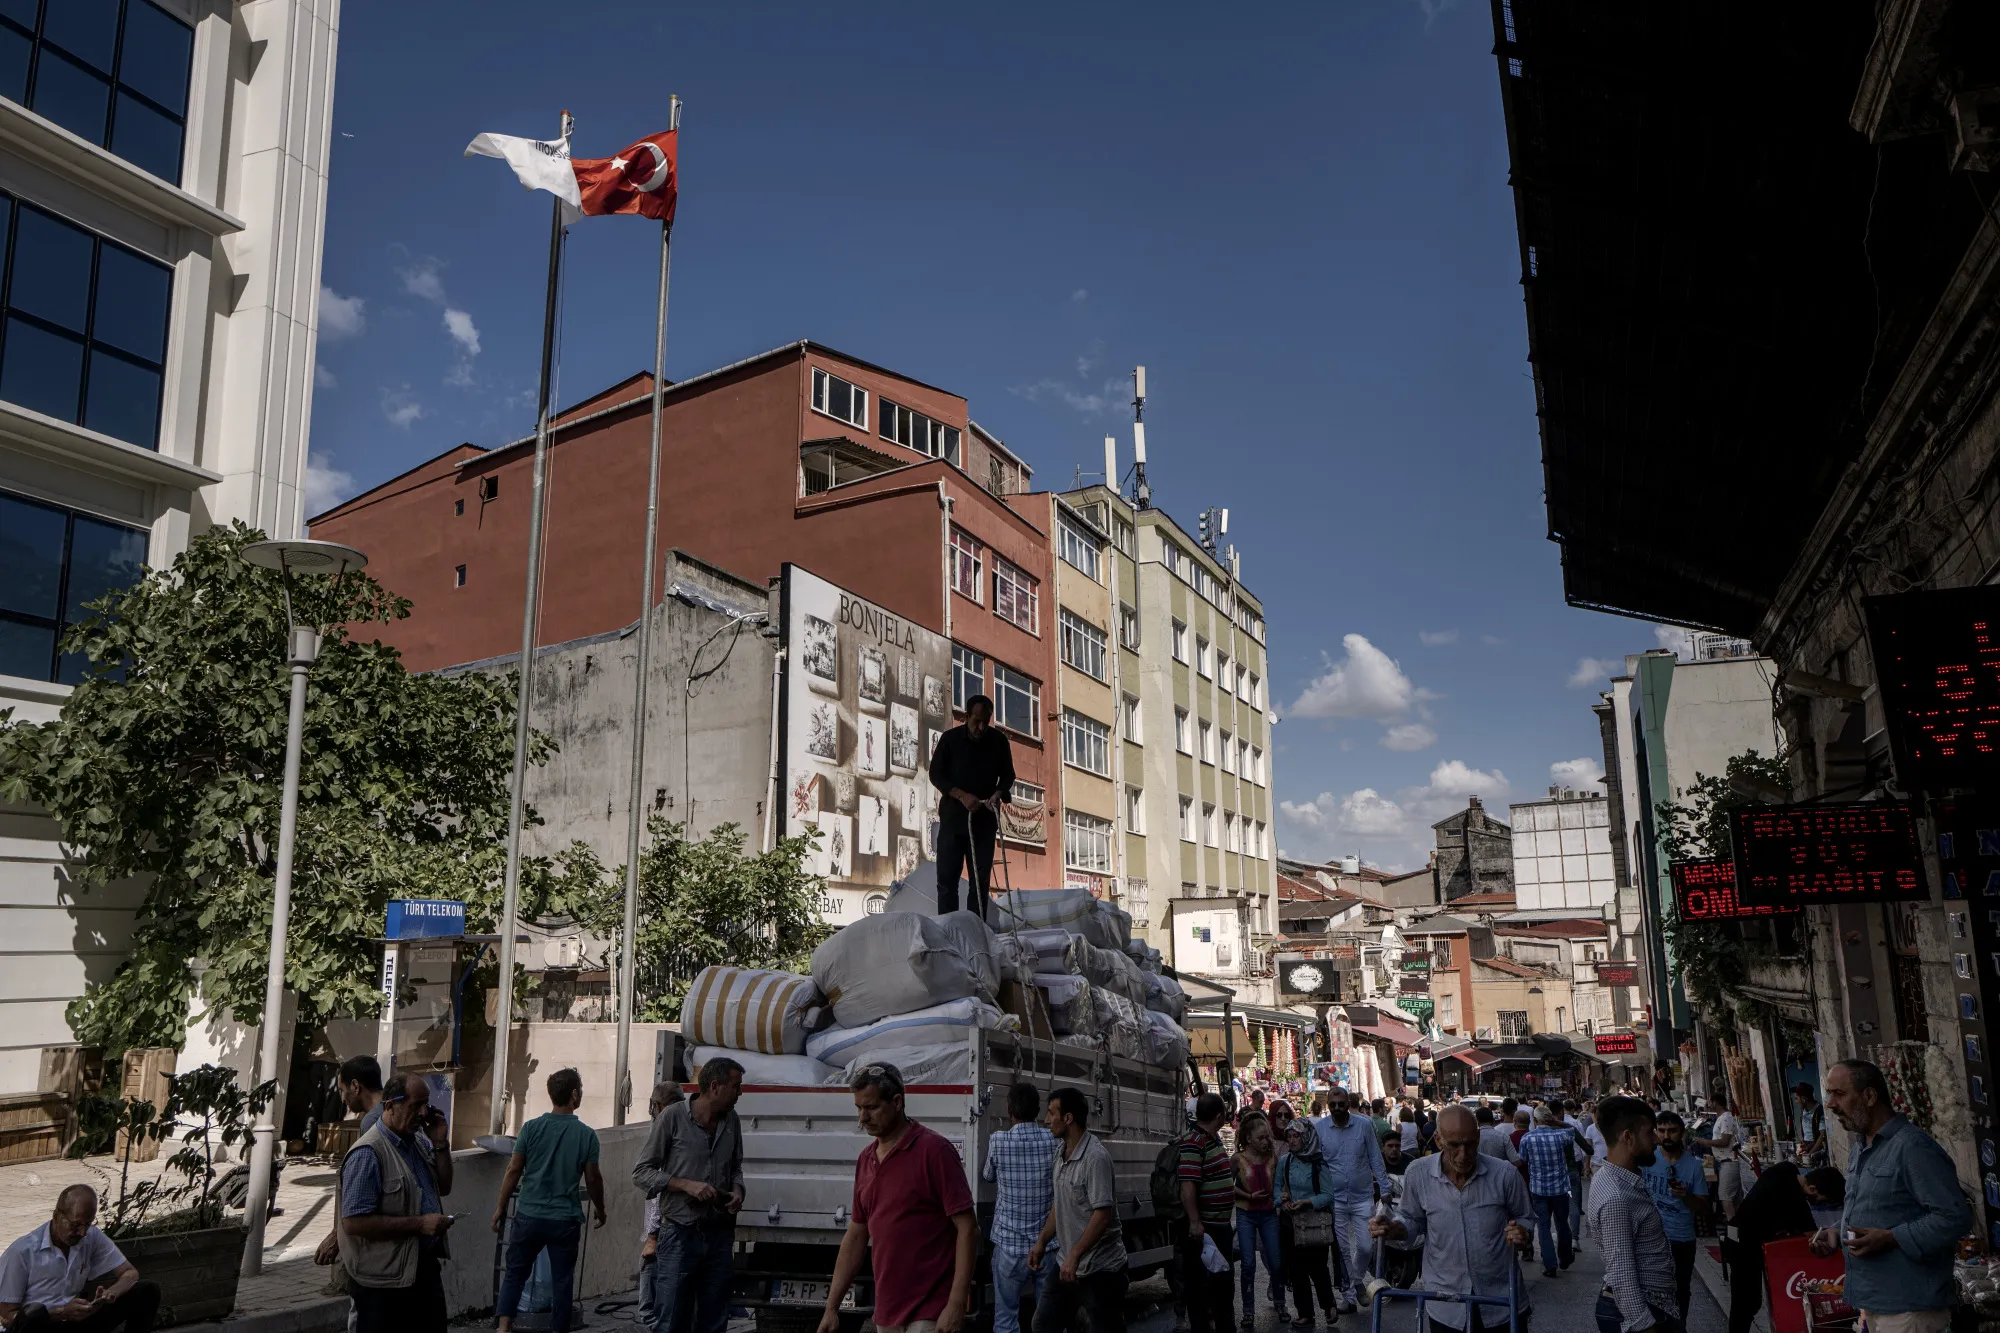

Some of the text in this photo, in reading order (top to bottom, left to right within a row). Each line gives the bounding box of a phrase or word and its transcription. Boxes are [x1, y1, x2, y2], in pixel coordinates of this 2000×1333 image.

[838, 593, 916, 654] BONJELA
[404, 901, 463, 917] TÜRK TELEKOM
[781, 1281, 853, 1301] 34 FP 35
